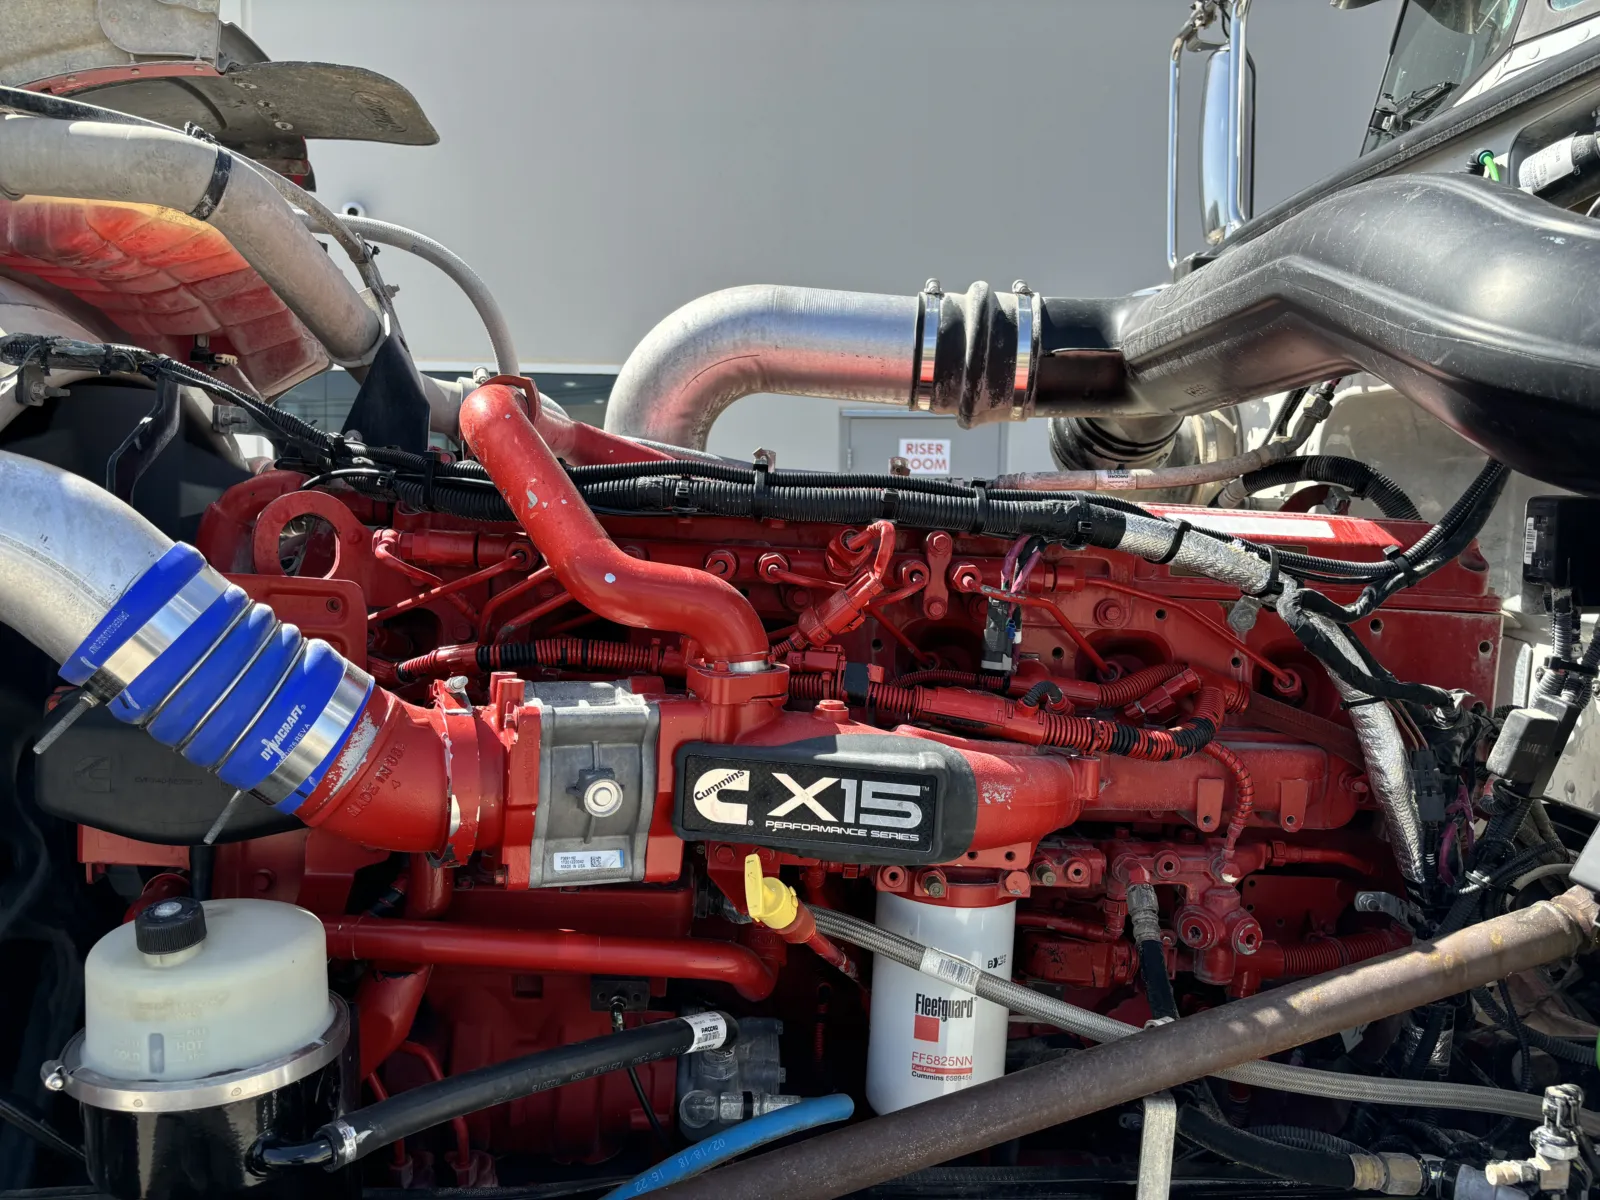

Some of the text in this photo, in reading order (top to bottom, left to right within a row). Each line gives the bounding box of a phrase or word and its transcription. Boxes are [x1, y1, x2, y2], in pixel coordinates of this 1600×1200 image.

[906, 443, 944, 455] RISER
[909, 458, 947, 470] OOM
[260, 704, 303, 761] DYNACRAFT
[694, 769, 746, 802] Cummins
[766, 771, 923, 829] X15
[765, 820, 920, 842] PERFORMANCE SERIES
[915, 993, 974, 1022] Fleetguard
[176, 1040, 205, 1052] HOT
[911, 1051, 973, 1067] FF5825NN
[911, 1070, 944, 1082] Cummins
[678, 1138, 726, 1168] 02/18/18
